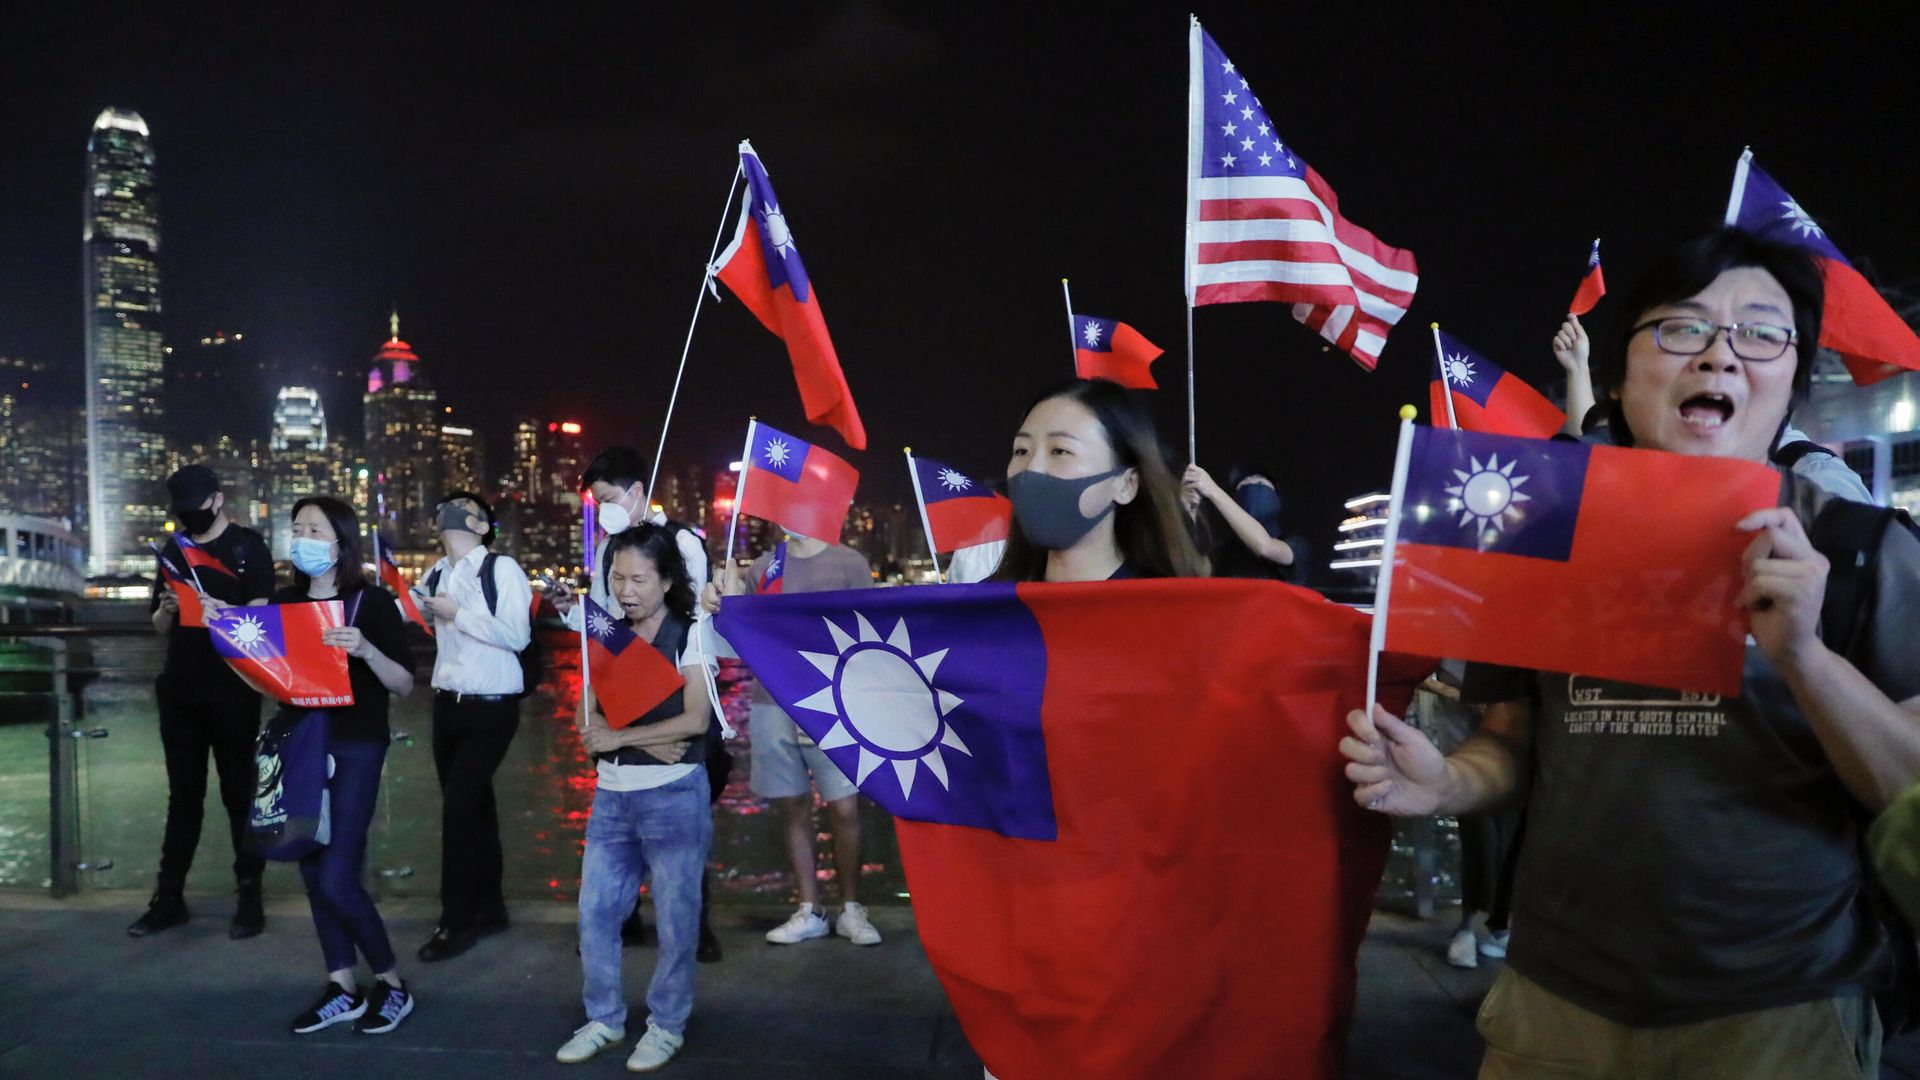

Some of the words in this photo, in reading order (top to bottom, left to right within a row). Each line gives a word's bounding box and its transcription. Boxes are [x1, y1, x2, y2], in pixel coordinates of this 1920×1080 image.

[1601, 710, 1612, 721] IN
[1616, 710, 1636, 722] THE
[1639, 711, 1673, 722] SOUTH
[1676, 712, 1727, 725] CENTRAL
[1594, 722, 1605, 732] OF
[1610, 722, 1630, 734] THE
[1632, 723, 1673, 735] UNITED
[1675, 724, 1719, 736] STATES
